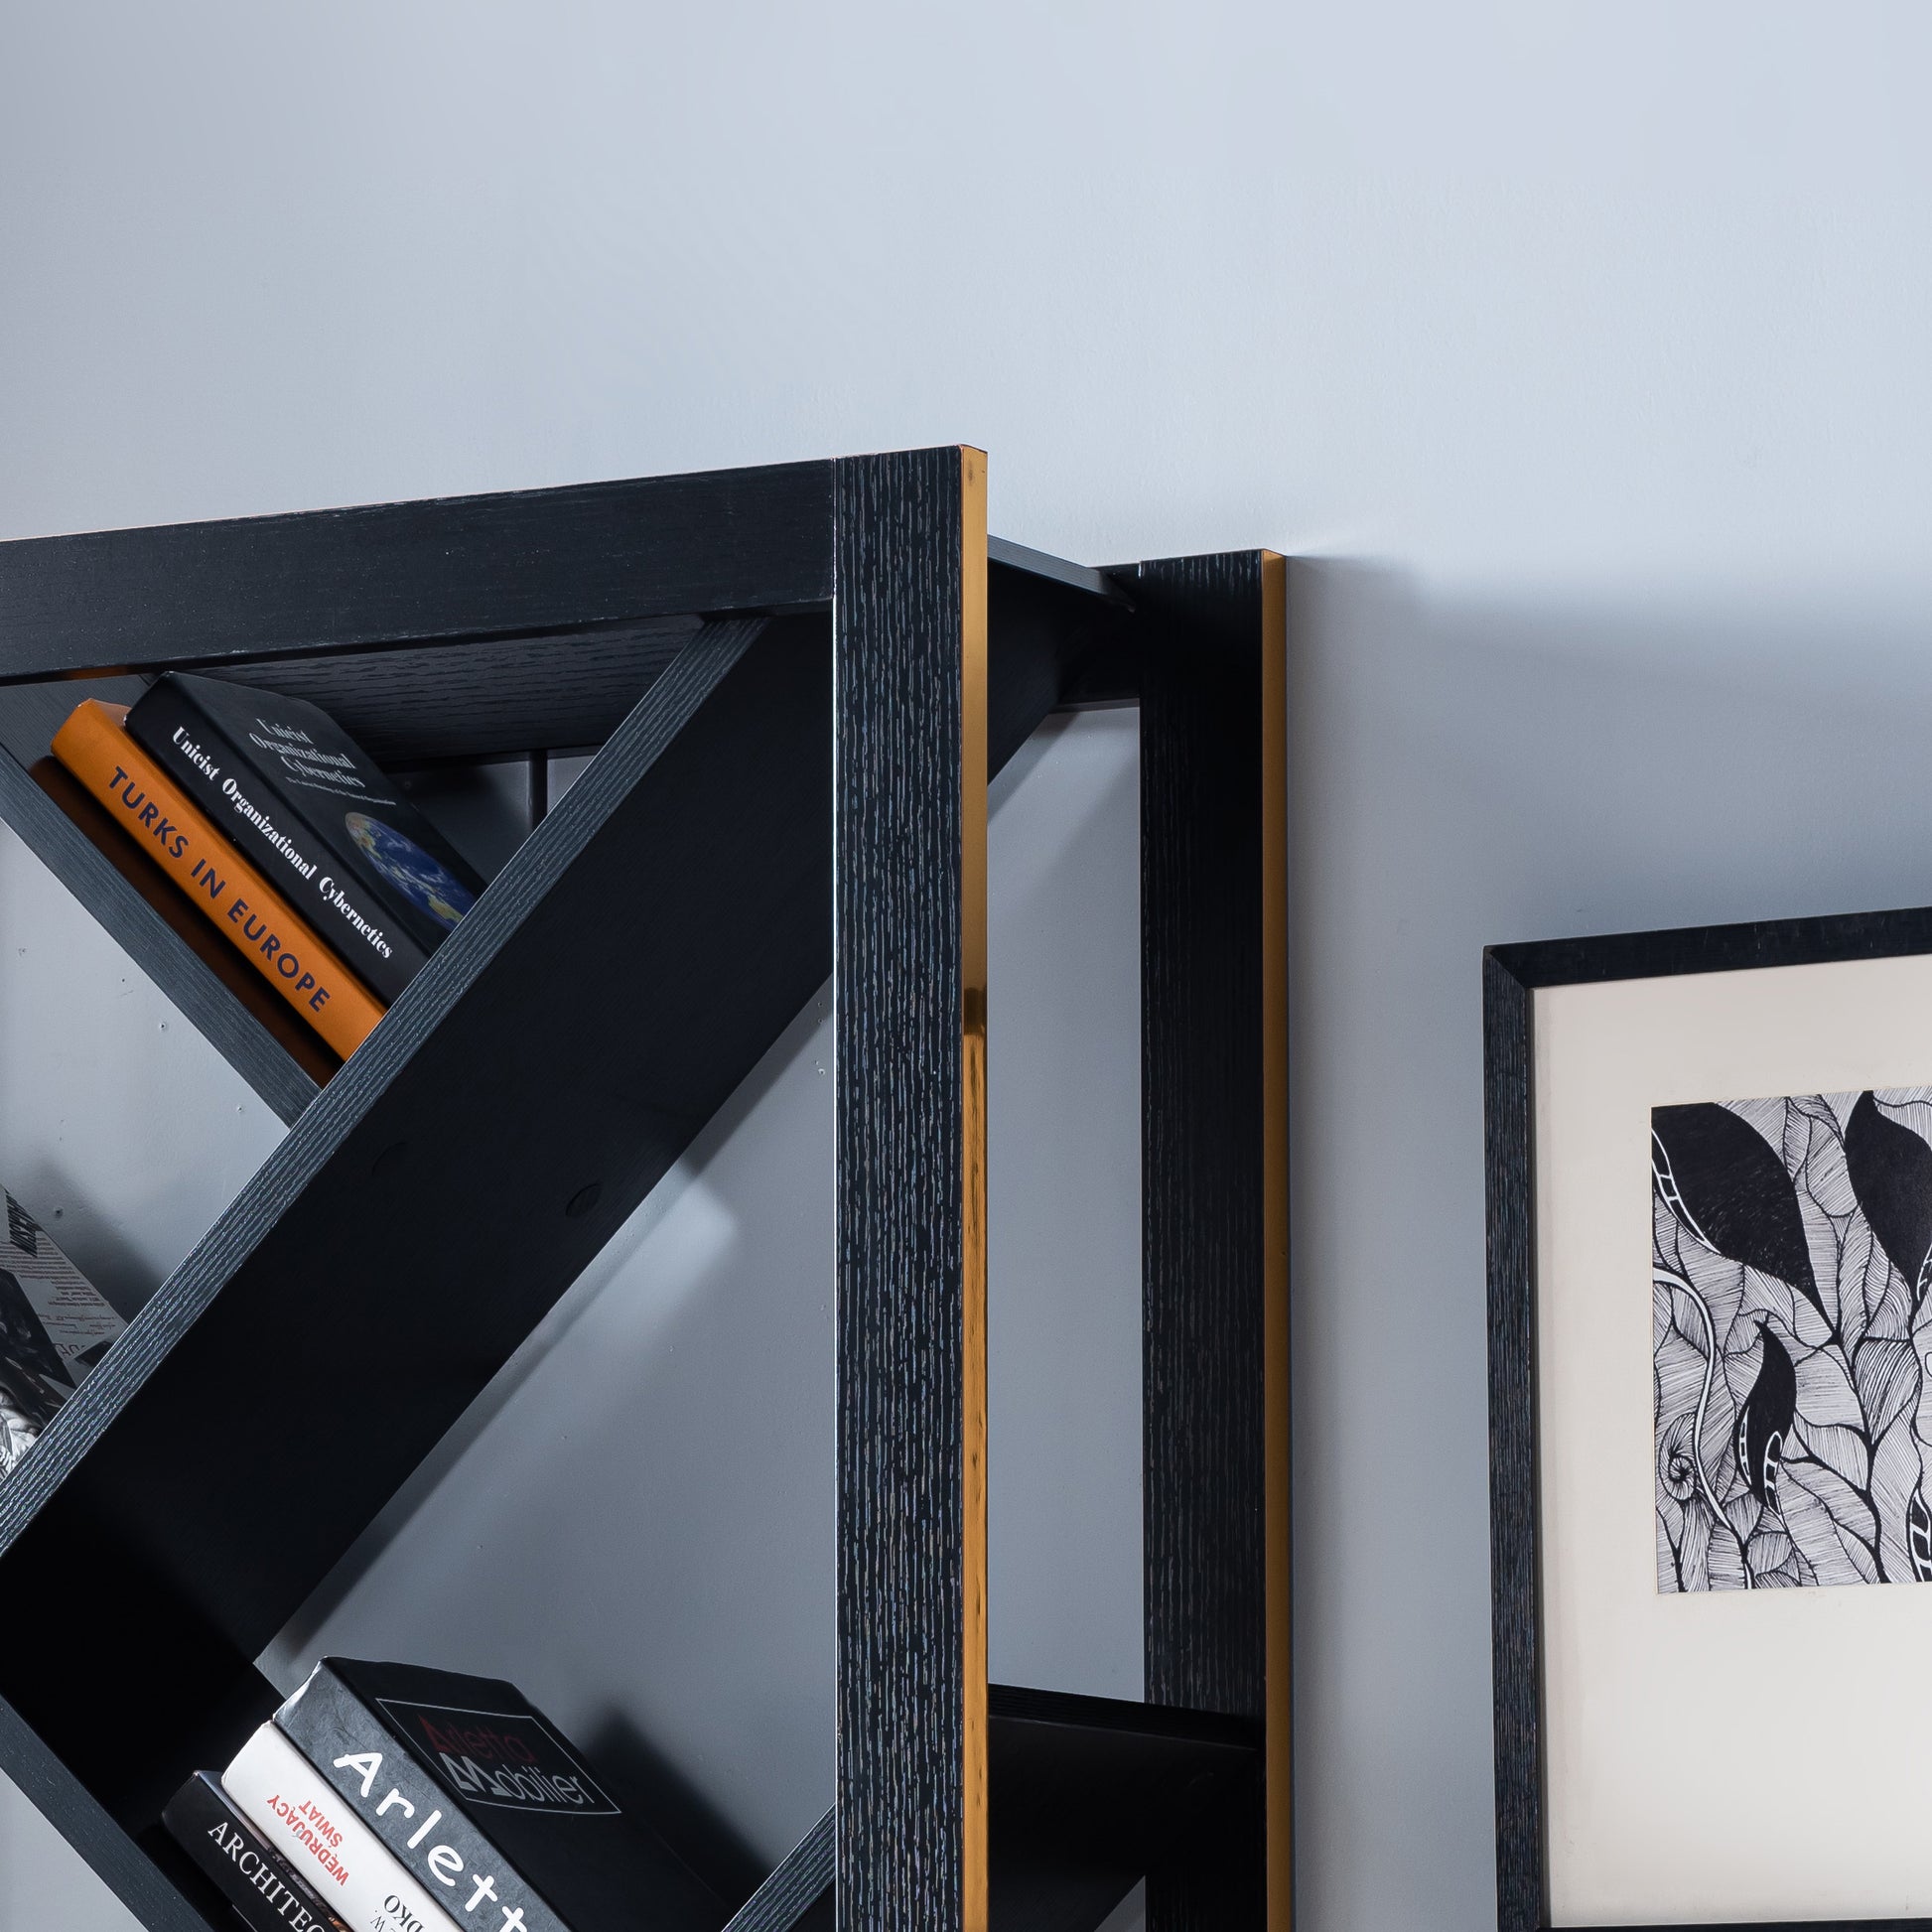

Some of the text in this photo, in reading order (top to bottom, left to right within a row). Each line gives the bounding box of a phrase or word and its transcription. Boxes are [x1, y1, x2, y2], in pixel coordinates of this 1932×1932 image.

[249, 732, 358, 769] Organizational
[255, 718, 315, 745] Unicist
[280, 756, 366, 788] Cybernetics
[173, 726, 220, 781] Unicist
[221, 777, 319, 881] Organizational
[319, 876, 394, 960] Cybernetics
[108, 765, 332, 1014] TURKS IN EUROPE
[418, 1714, 539, 1763] Arletta
[438, 1750, 596, 1805] Mobilier
[266, 1794, 349, 1887] WĘDRUJĄCY
[298, 1799, 344, 1849] ŚWIAT
[333, 1751, 528, 1932] Arlett
